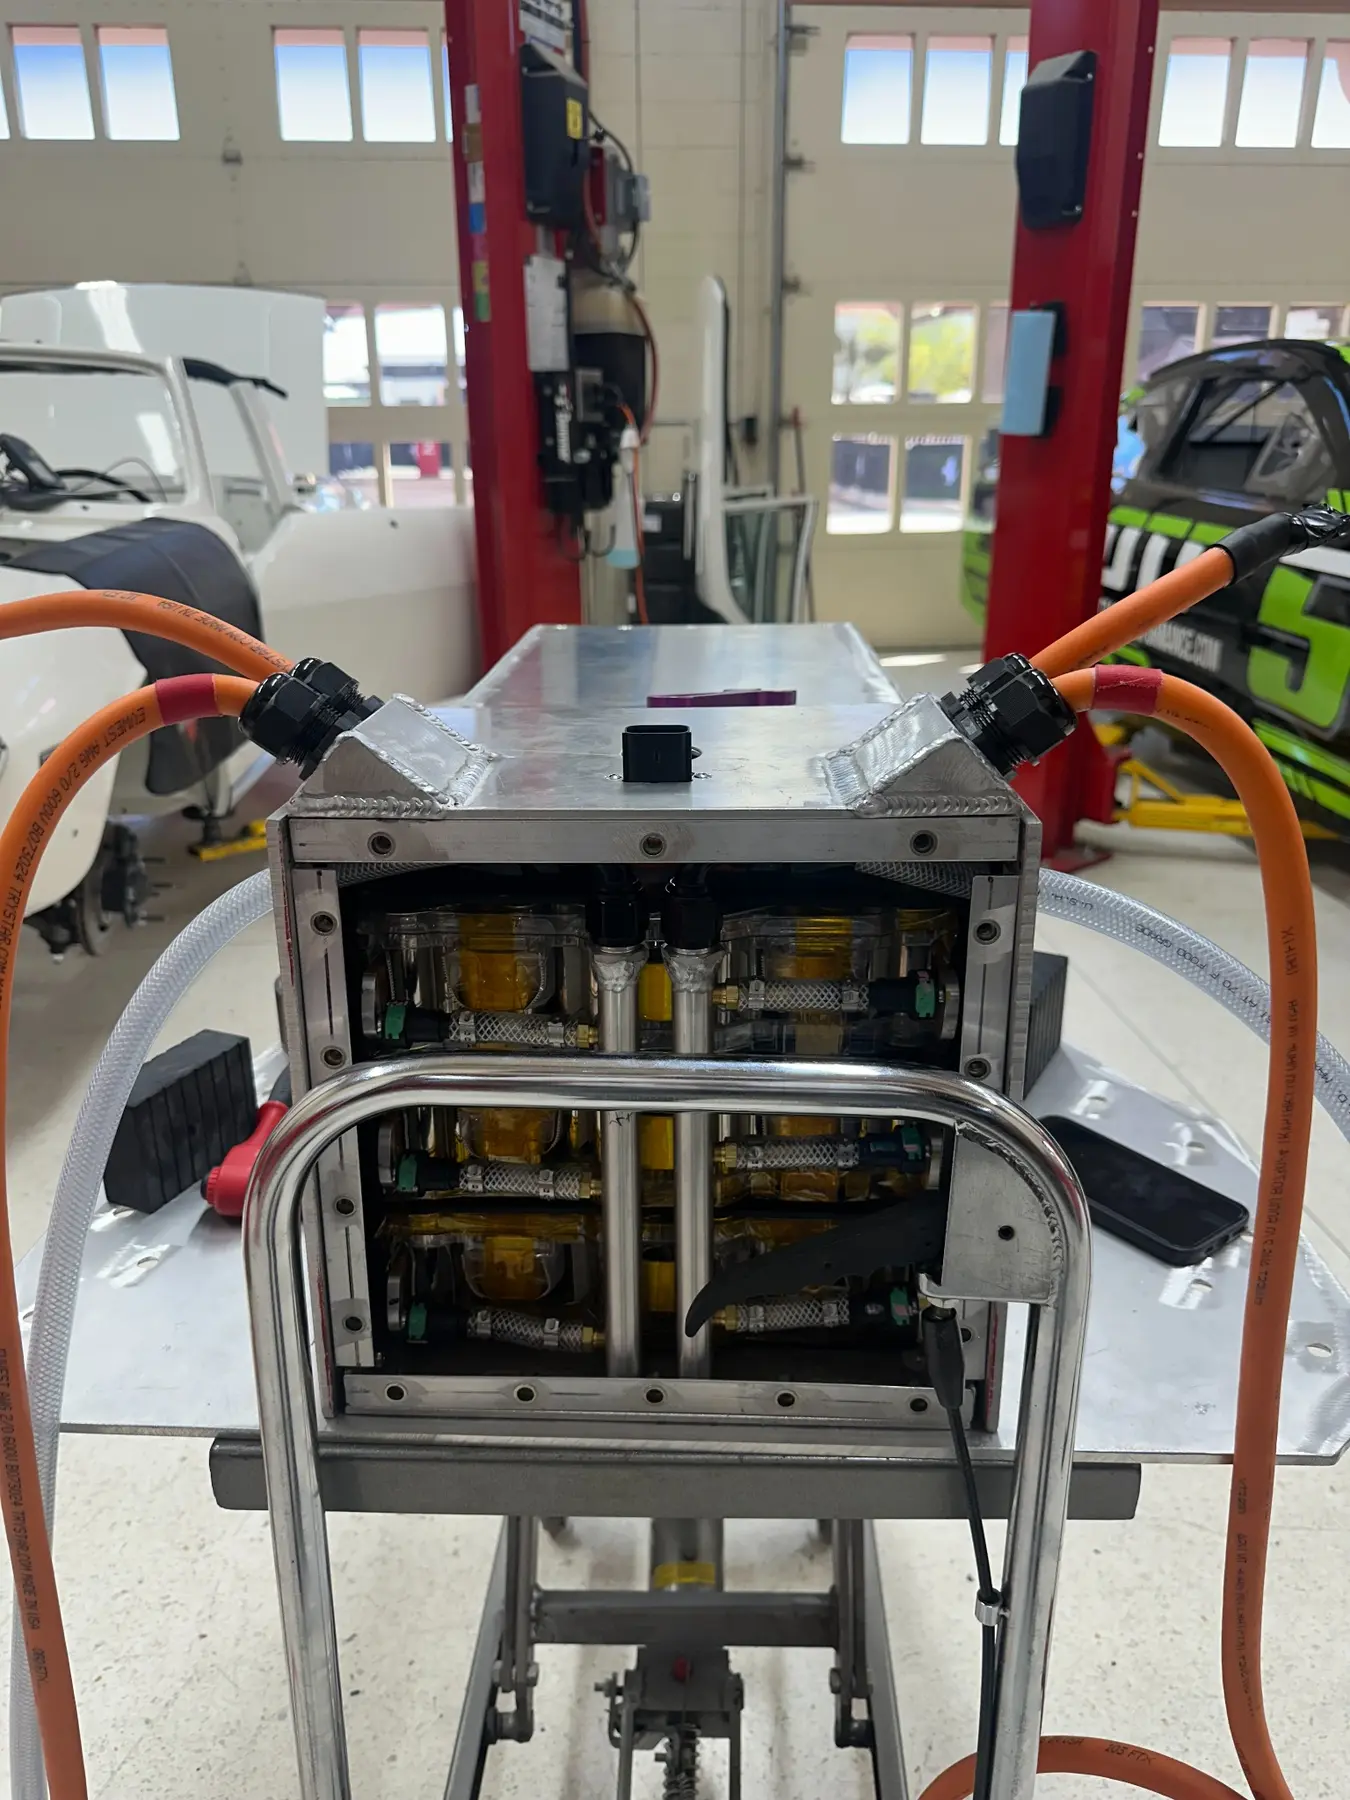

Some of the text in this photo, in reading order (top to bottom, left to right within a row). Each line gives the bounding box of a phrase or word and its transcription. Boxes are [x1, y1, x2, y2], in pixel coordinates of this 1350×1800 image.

[59, 762, 81, 791] 2/0
[1135, 923, 1172, 948] GRADE
[1176, 948, 1207, 970] FOOD
[1222, 979, 1239, 993] 70
